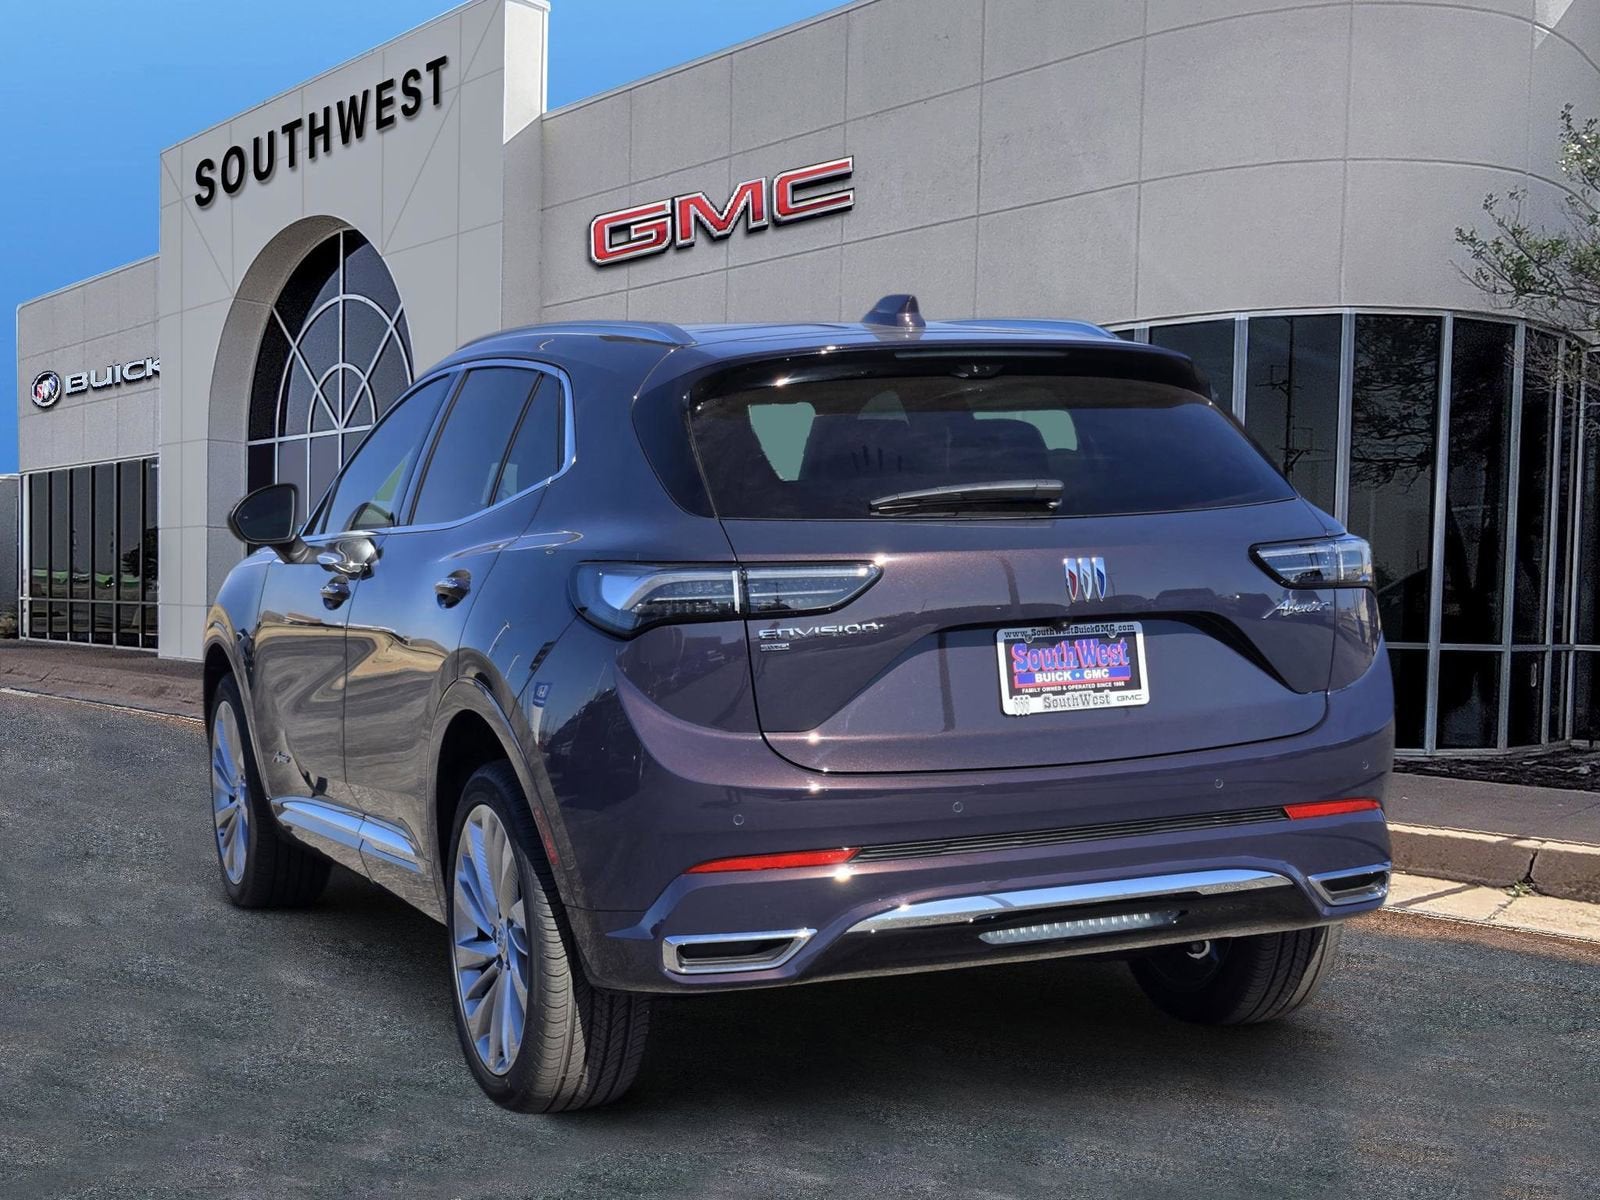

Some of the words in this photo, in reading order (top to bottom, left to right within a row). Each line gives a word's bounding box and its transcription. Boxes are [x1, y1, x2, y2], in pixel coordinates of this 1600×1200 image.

[194, 55, 448, 208] SOUTHWEST
[588, 156, 855, 266] GMC
[64, 356, 160, 395] BUICK
[1011, 638, 1130, 673] SouthWest
[1034, 671, 1073, 683] BUICK
[1083, 668, 1110, 678] GMC
[1068, 682, 1095, 690] OPERATED
[1043, 692, 1111, 709] SouthWest
[1116, 694, 1142, 702] GMC
